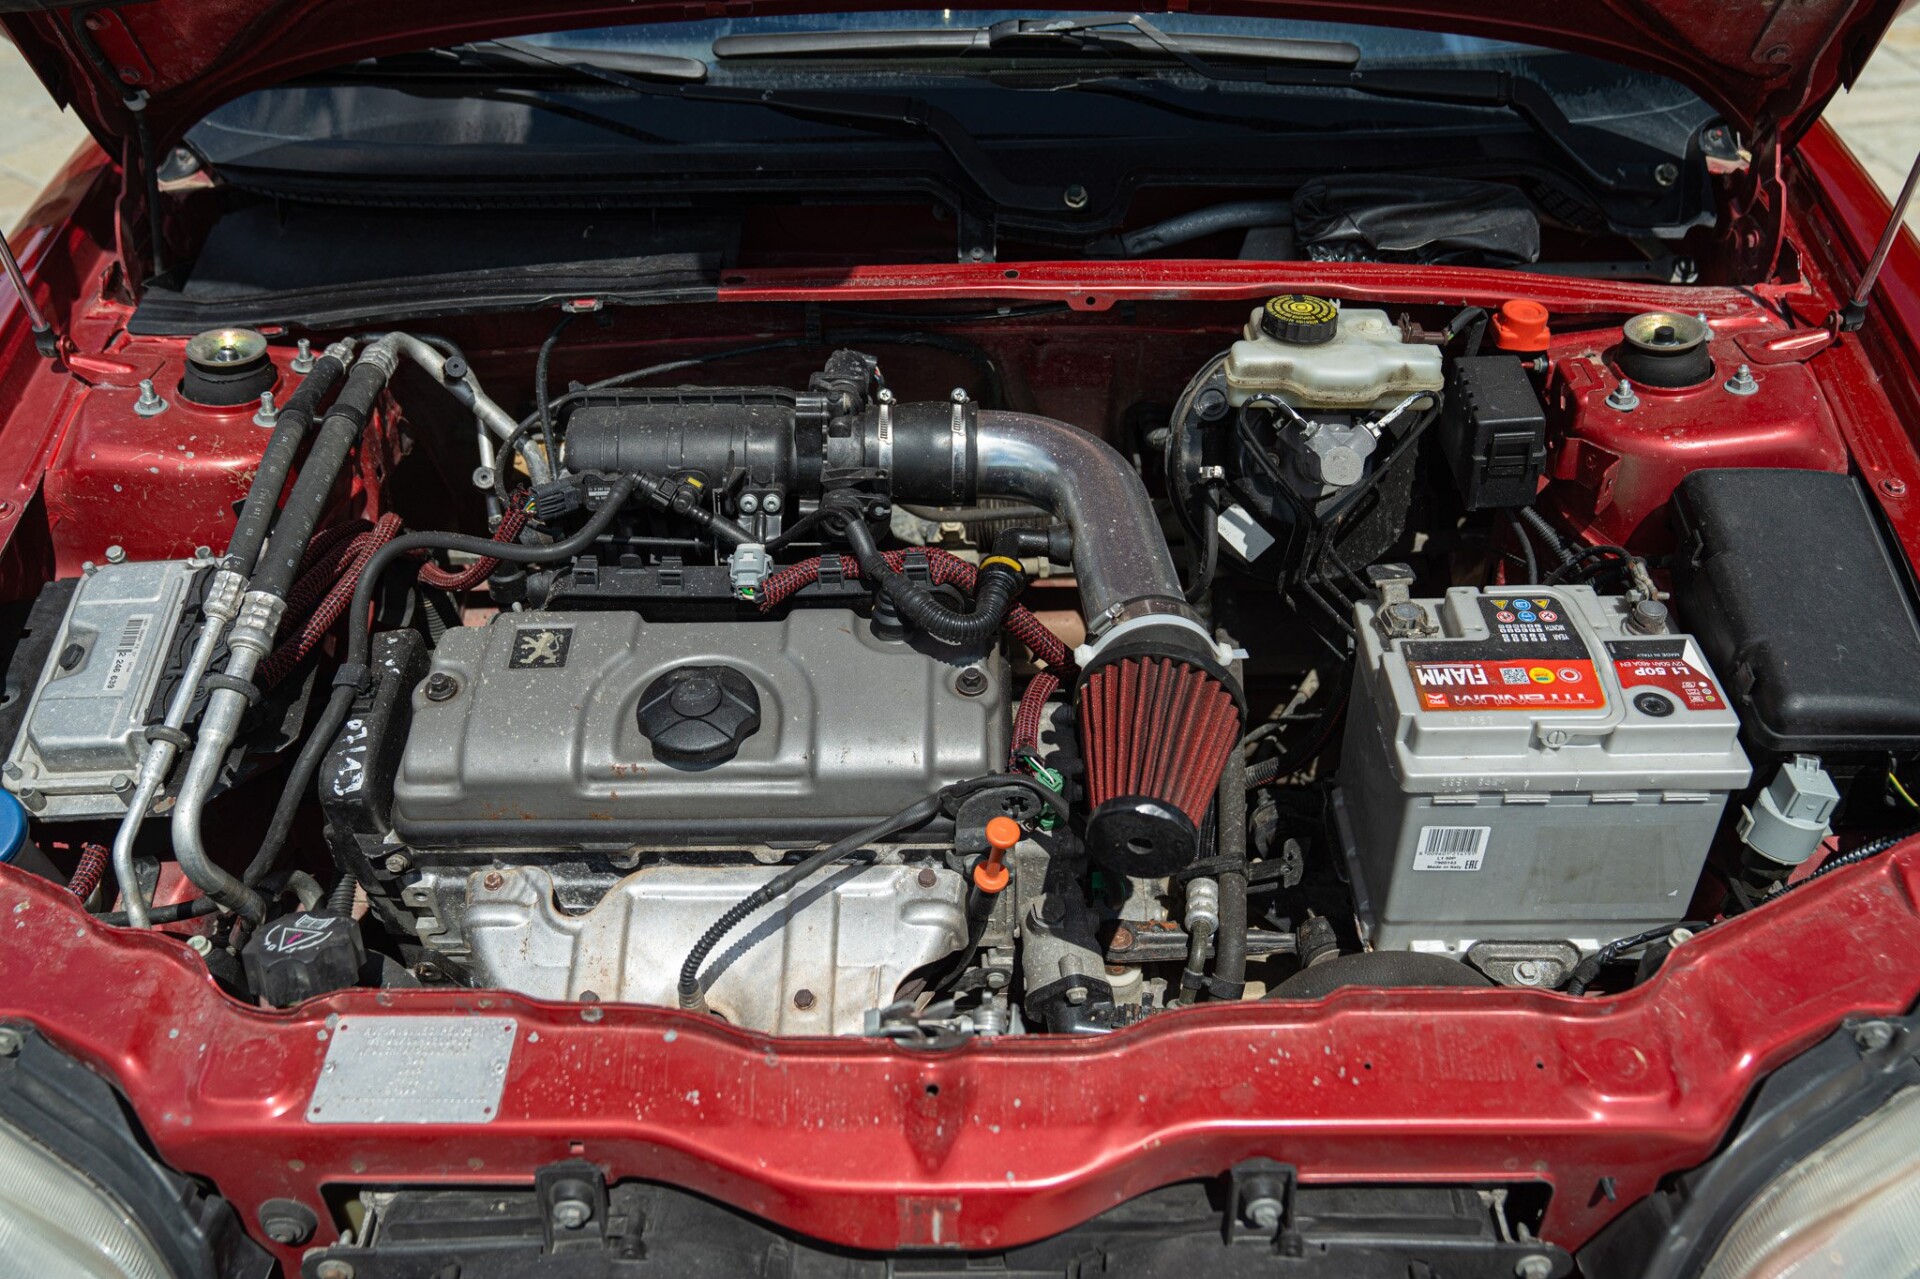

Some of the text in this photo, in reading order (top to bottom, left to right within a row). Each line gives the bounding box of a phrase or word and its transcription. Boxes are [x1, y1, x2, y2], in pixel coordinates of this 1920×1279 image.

[1415, 667, 1489, 686] FIAMM
[1634, 666, 1691, 676] L1 50P
